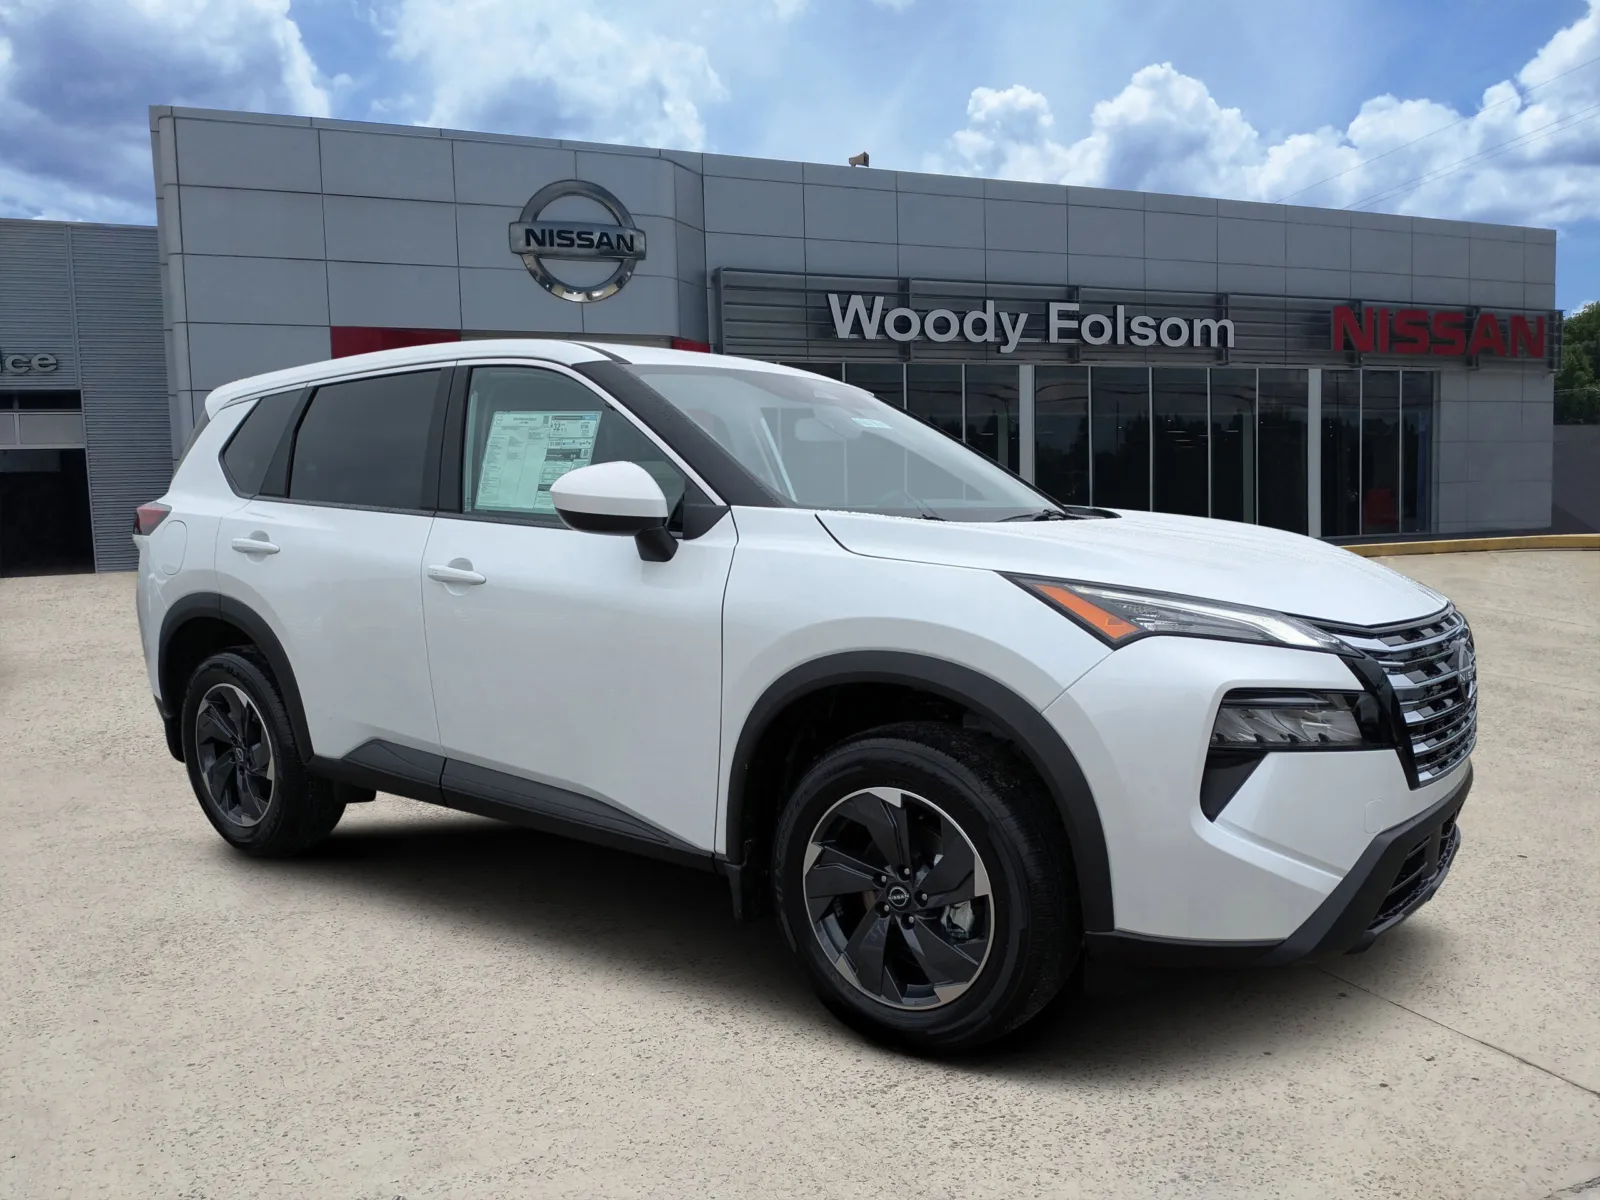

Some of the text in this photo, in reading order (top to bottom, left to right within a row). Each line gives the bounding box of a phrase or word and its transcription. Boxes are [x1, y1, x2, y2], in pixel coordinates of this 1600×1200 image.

[525, 228, 634, 252] NISSAN
[827, 293, 1236, 353] Woody Folsom
[1333, 305, 1545, 358] NISSAN
[0, 352, 58, 374] ce
